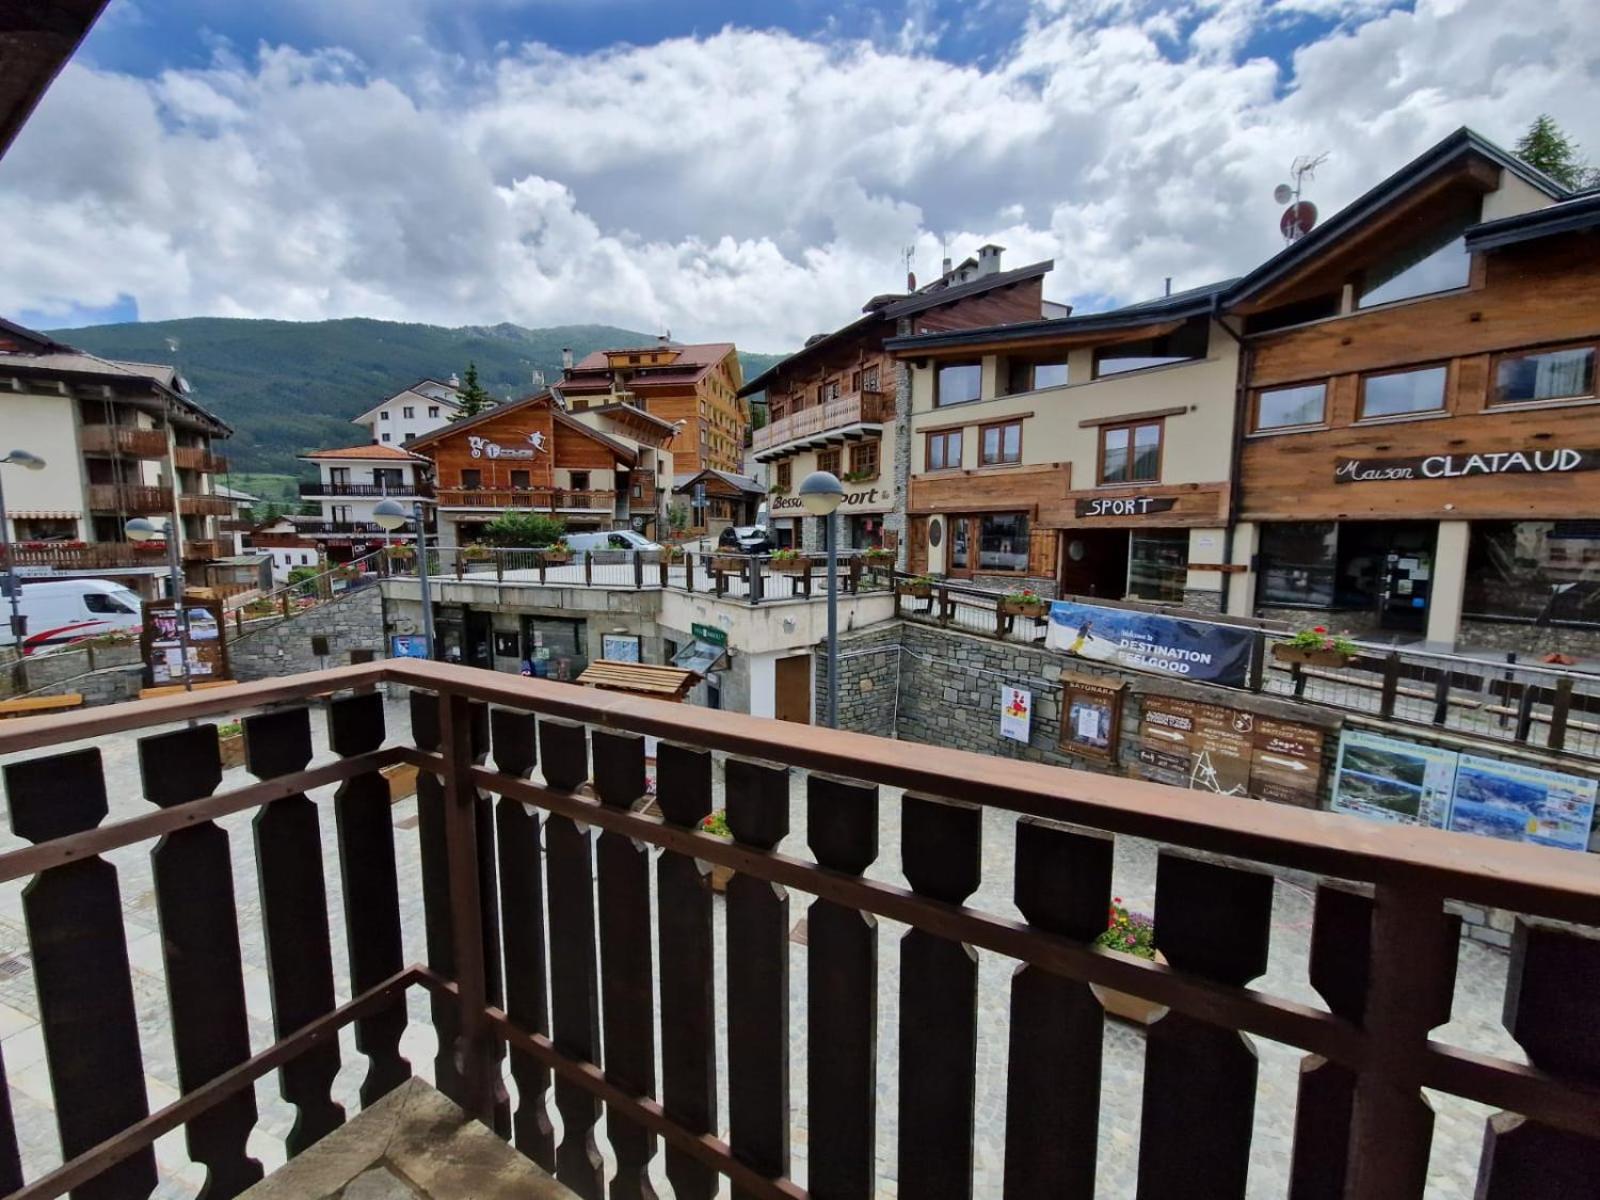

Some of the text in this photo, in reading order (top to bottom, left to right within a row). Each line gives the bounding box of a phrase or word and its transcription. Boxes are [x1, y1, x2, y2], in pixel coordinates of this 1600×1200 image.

[1336, 449, 1582, 480] Maison CLATAUD
[772, 495, 805, 510] Besso
[1085, 498, 1154, 516] SPORT
[1118, 651, 1190, 674] FEELGOOD
[1120, 639, 1212, 665] DESTINATION
